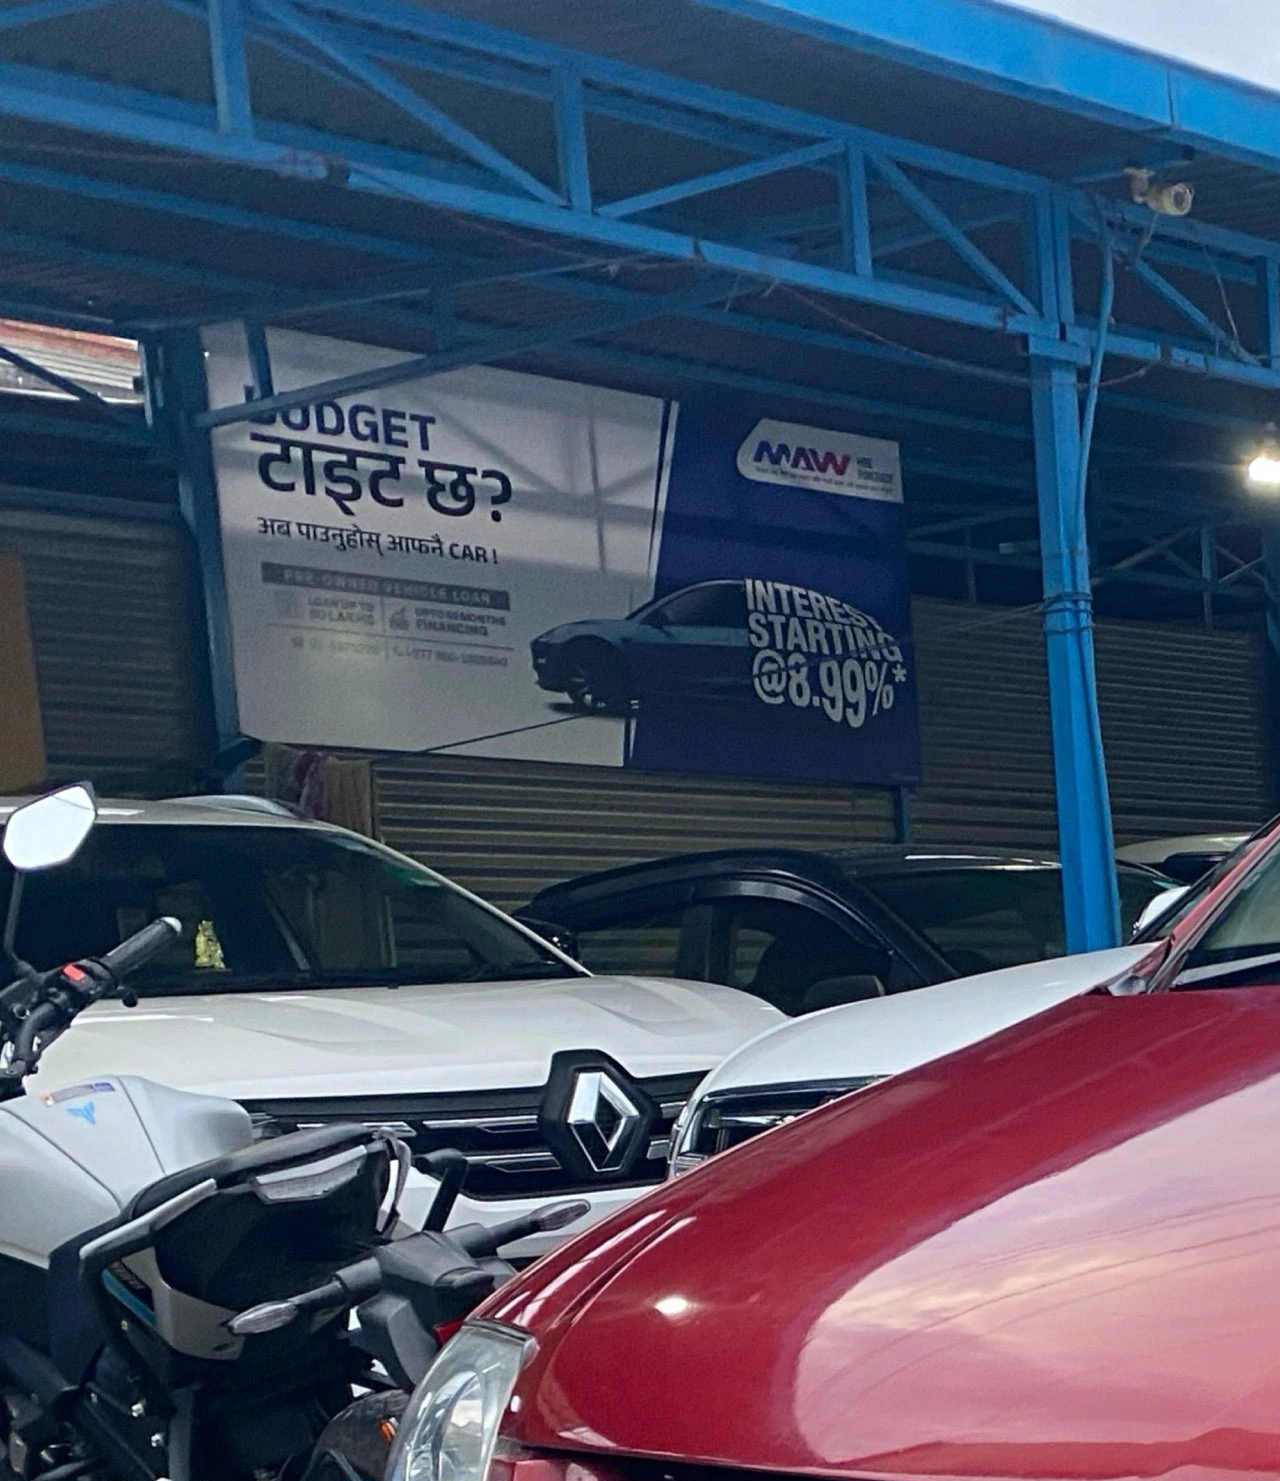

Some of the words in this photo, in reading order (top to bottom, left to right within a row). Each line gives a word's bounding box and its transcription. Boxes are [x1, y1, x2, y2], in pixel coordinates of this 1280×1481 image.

[250, 432, 406, 516] टाइट
[417, 459, 512, 522] छ?
[753, 440, 850, 476] MAW
[257, 517, 291, 537] अब
[295, 522, 384, 557] पाउनुहोस्
[449, 543, 488, 563] CAR
[744, 578, 882, 632] INTEREST
[749, 612, 904, 662] STARTING
